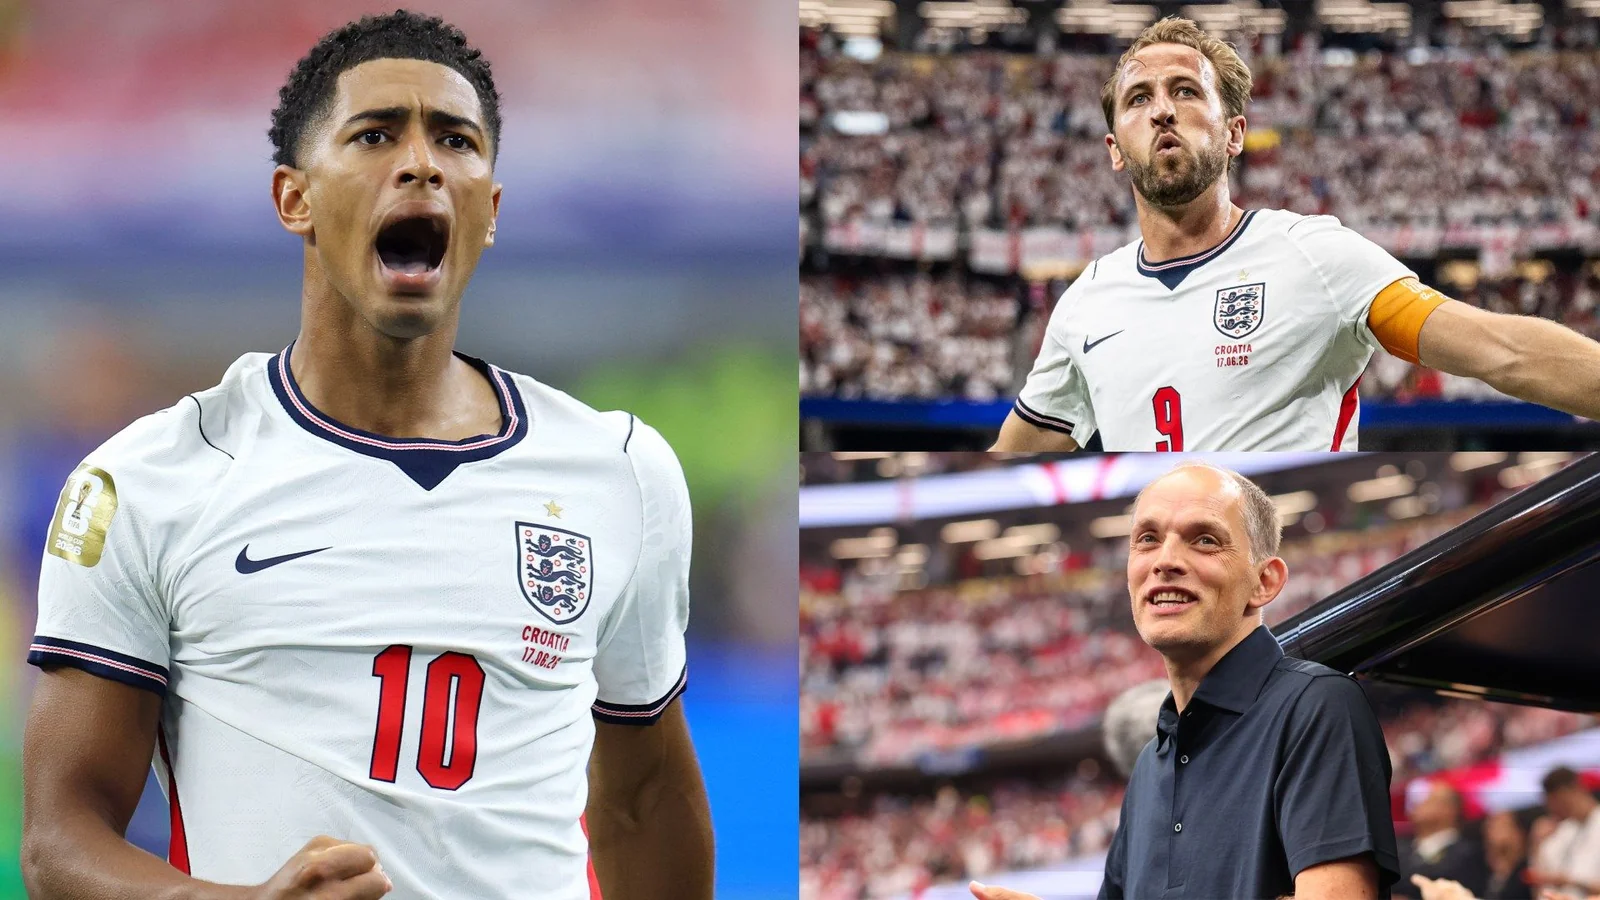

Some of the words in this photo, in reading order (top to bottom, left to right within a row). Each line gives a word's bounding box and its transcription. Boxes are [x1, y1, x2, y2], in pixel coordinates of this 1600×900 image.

[1214, 344, 1252, 355] CROATIA
[1217, 355, 1249, 368] 17.06.26
[1152, 386, 1184, 452] 9
[67, 519, 81, 529] FIFA
[55, 539, 82, 556] 2026
[521, 625, 570, 653] CROATIA
[369, 644, 486, 791] 10
